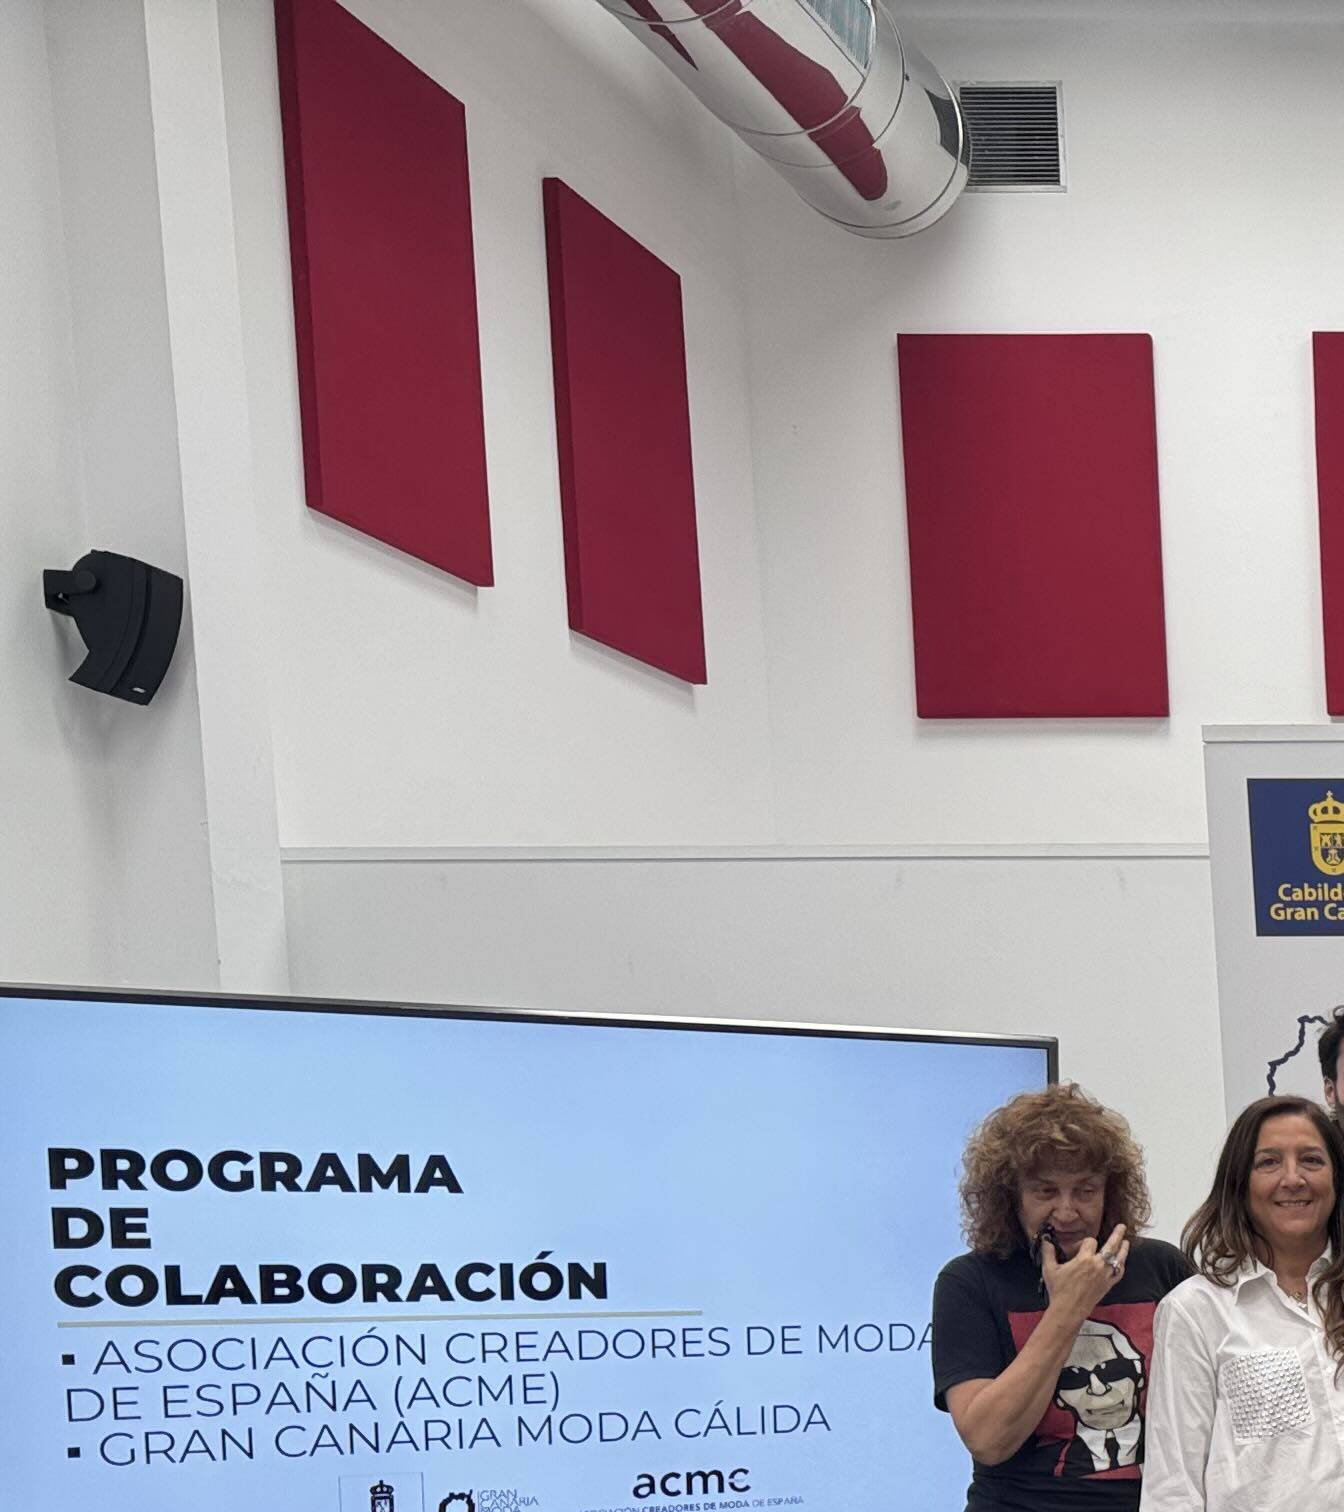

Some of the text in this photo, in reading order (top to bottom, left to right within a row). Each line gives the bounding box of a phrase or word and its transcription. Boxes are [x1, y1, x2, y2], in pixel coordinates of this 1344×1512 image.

[1269, 903, 1320, 921] Gran
[47, 1147, 465, 1194] PROGRAMA
[50, 1206, 152, 1250] DE
[53, 1250, 608, 1309] COLABORACIÓN
[92, 1327, 426, 1375] ASOCIACIÓN
[445, 1326, 731, 1364] CREADORES
[746, 1326, 803, 1356] DE
[66, 1371, 560, 1423] DE ESPAÑA (ACME)
[99, 1401, 831, 1467] GRAN CANARIA MODA CÁLIDA
[703, 1501, 717, 1512] DE
[718, 1500, 750, 1511] MODA
